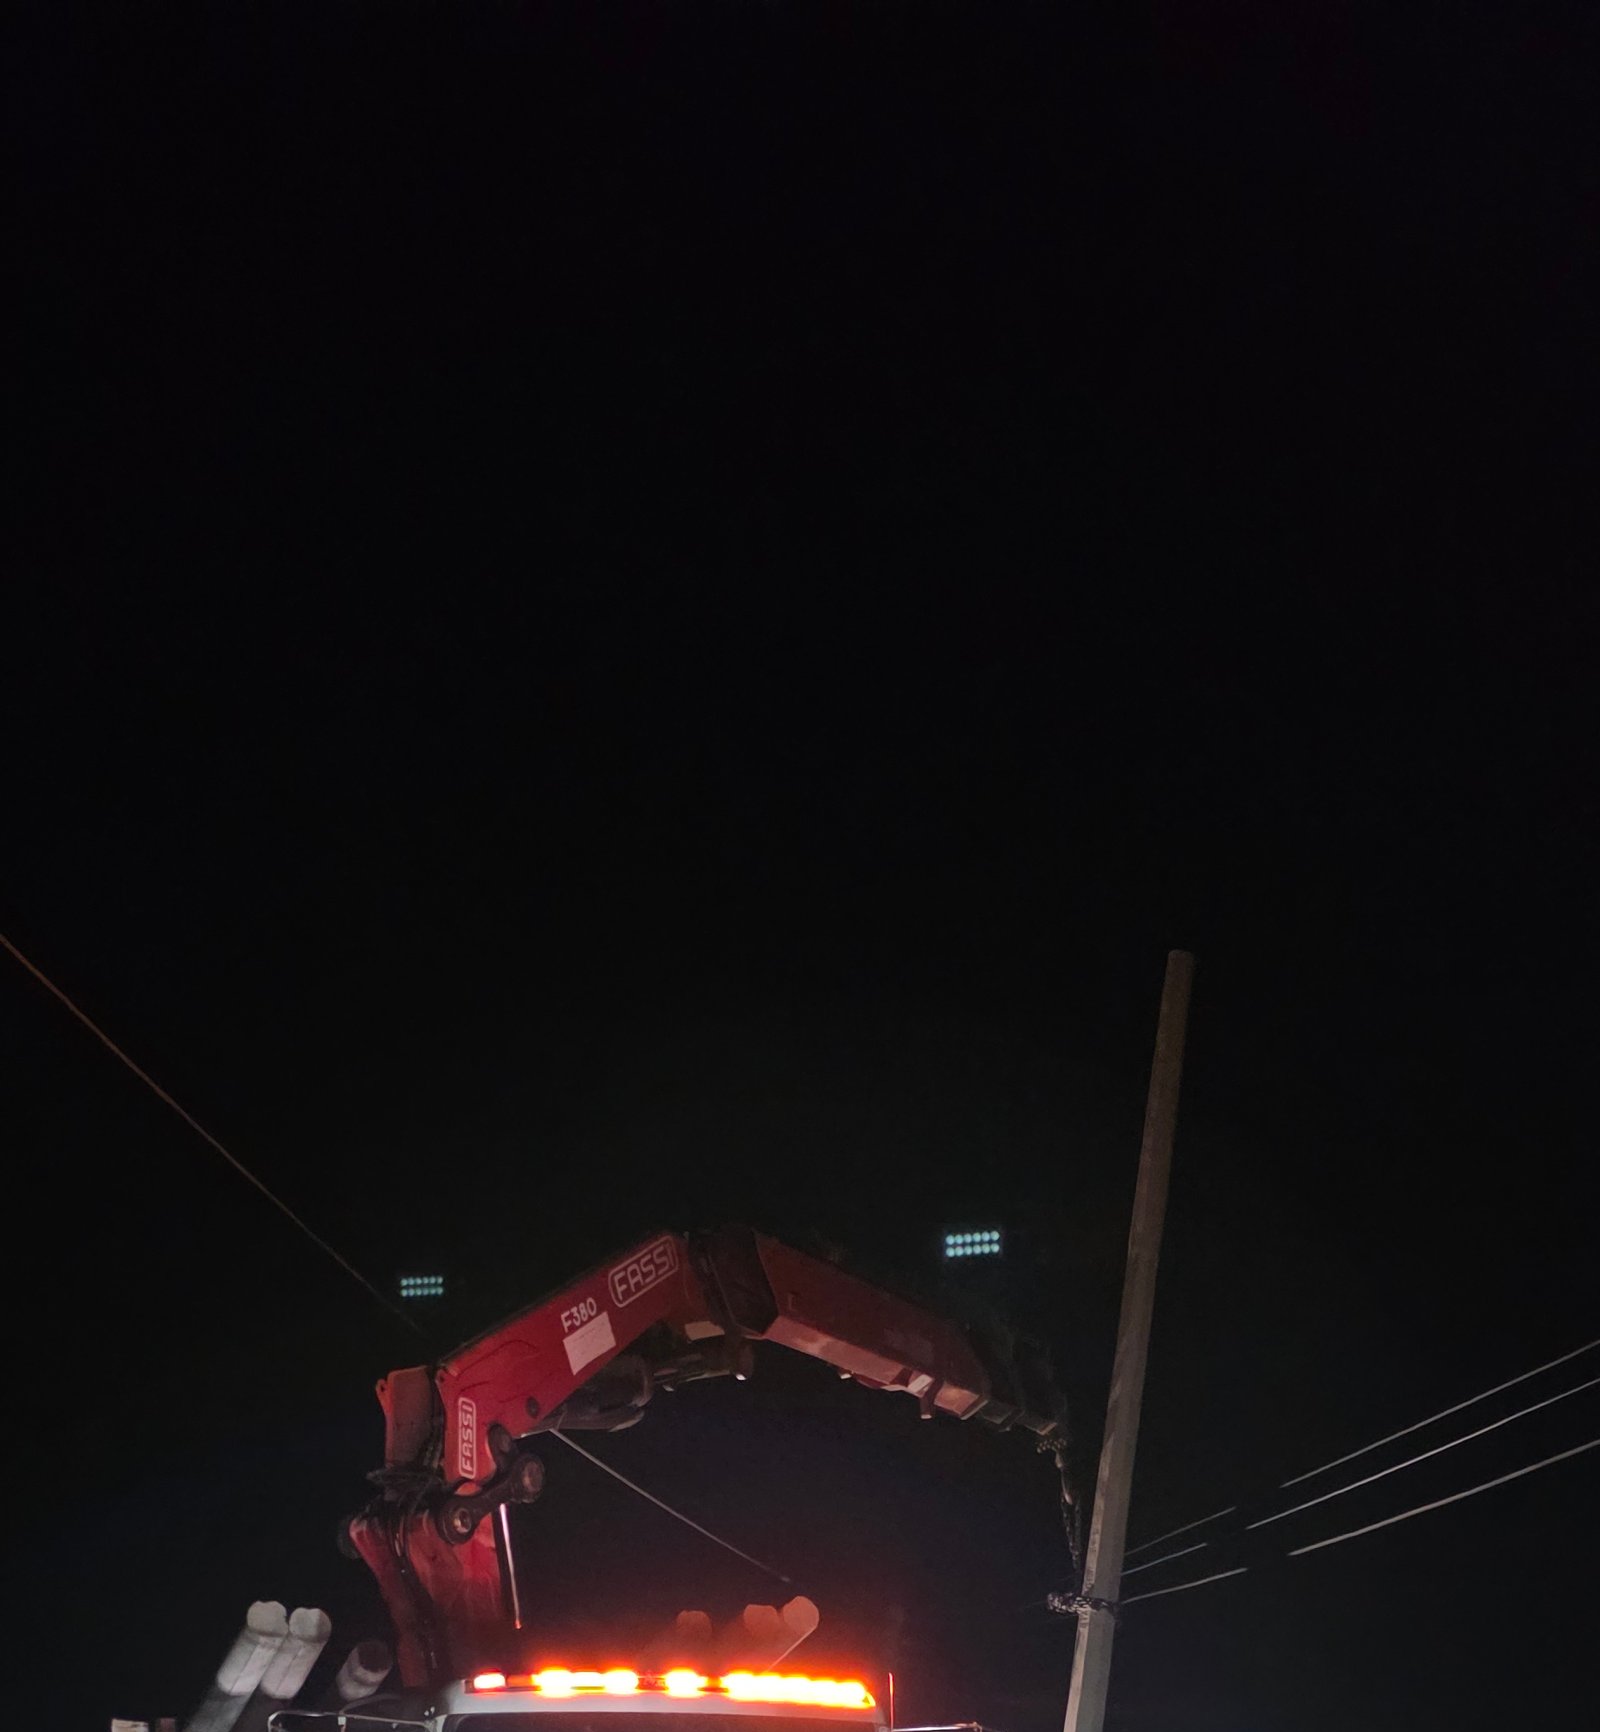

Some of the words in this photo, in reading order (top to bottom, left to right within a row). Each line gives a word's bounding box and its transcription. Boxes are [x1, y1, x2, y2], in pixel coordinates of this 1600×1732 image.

[613, 1241, 675, 1301] FASSI
[560, 1297, 597, 1333] F380
[462, 1404, 473, 1472] FASSI
